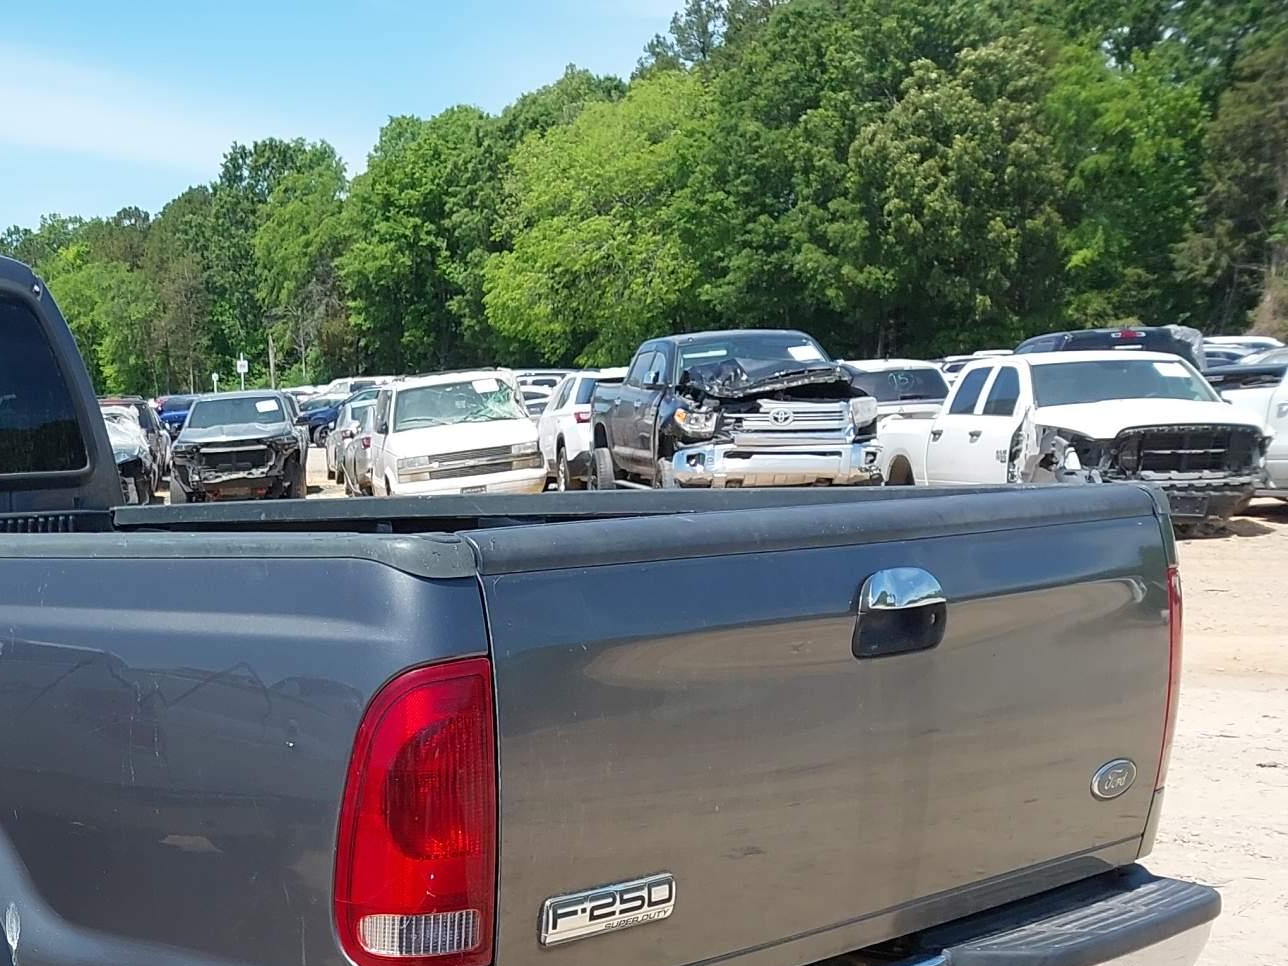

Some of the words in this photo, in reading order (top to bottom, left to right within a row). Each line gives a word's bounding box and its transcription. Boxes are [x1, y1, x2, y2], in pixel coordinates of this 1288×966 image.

[551, 877, 673, 931] F-250
[604, 917, 639, 930] SUPER
[641, 908, 671, 921] DUTY
